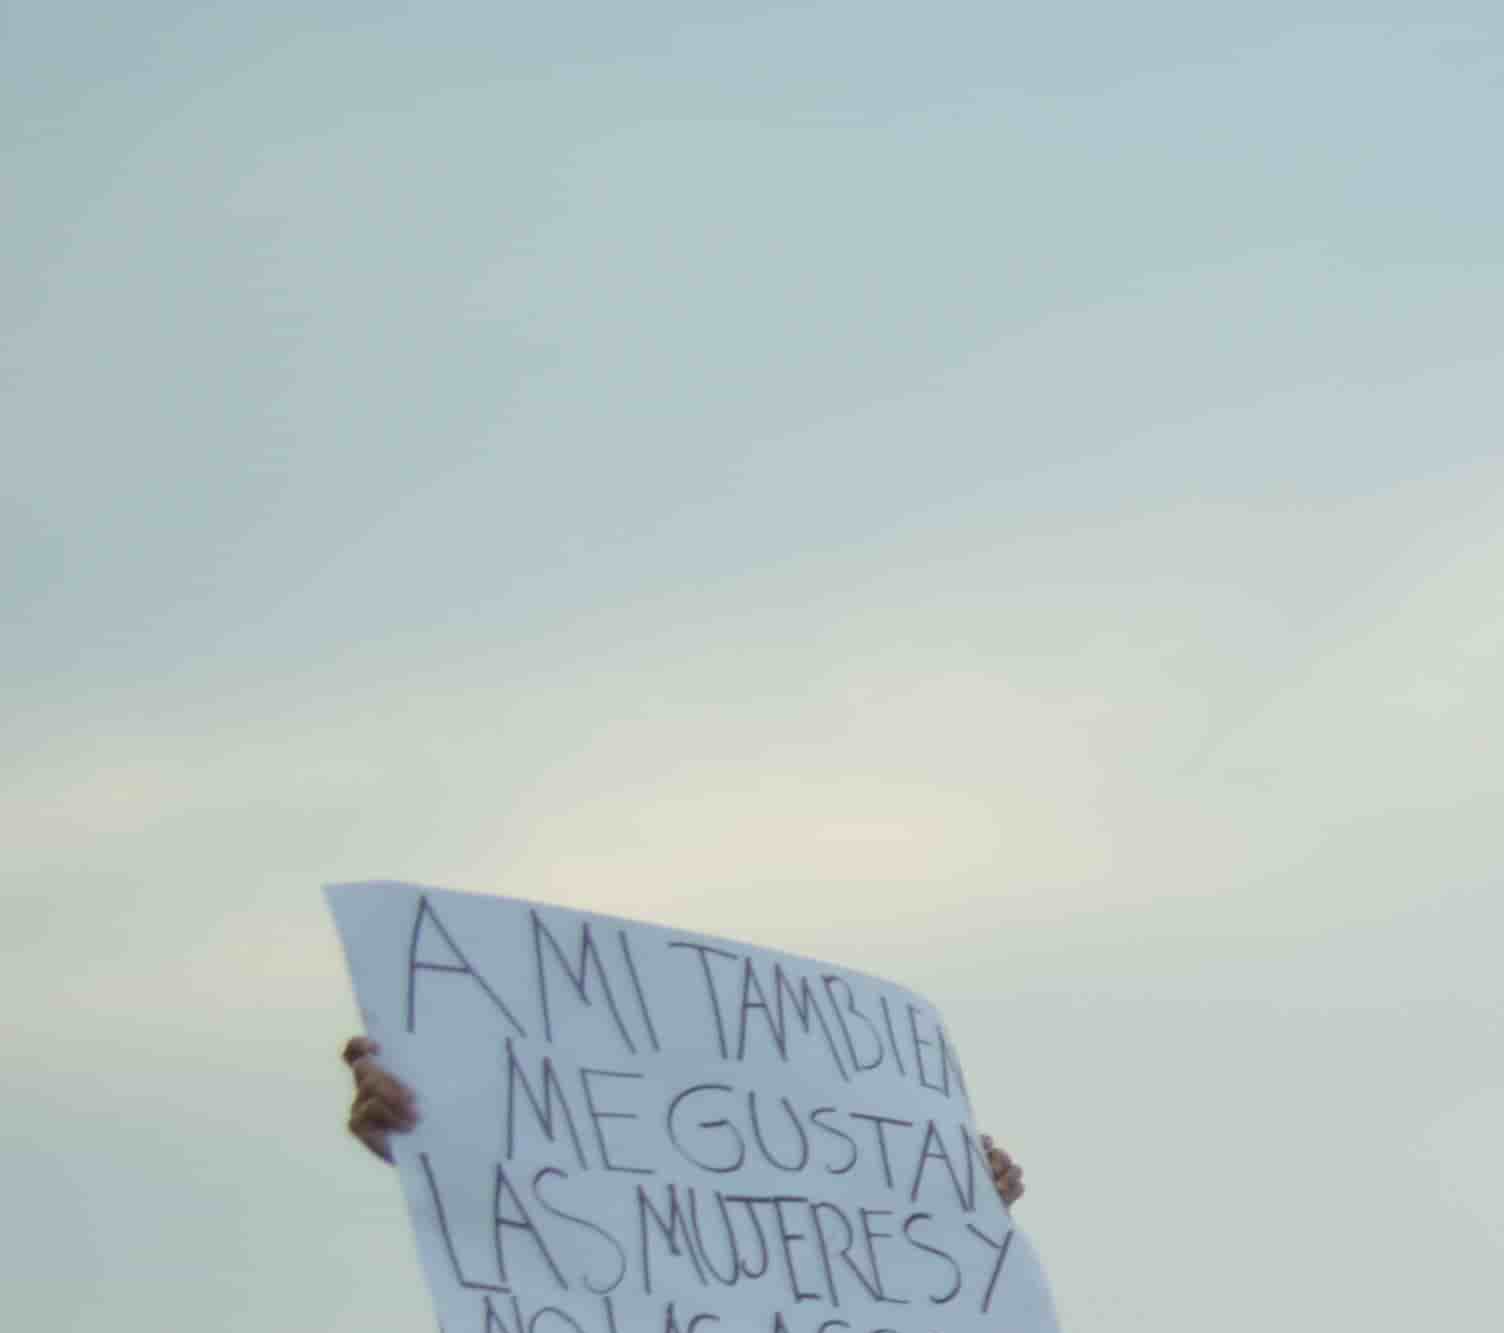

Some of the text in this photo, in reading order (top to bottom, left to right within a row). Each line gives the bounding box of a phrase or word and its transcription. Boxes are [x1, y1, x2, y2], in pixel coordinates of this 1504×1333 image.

[406, 895, 964, 1097] A MI TAMBIEN
[505, 1037, 985, 1212] ME GUSTAN
[420, 1152, 1014, 1313] LAS MUJERES Y
